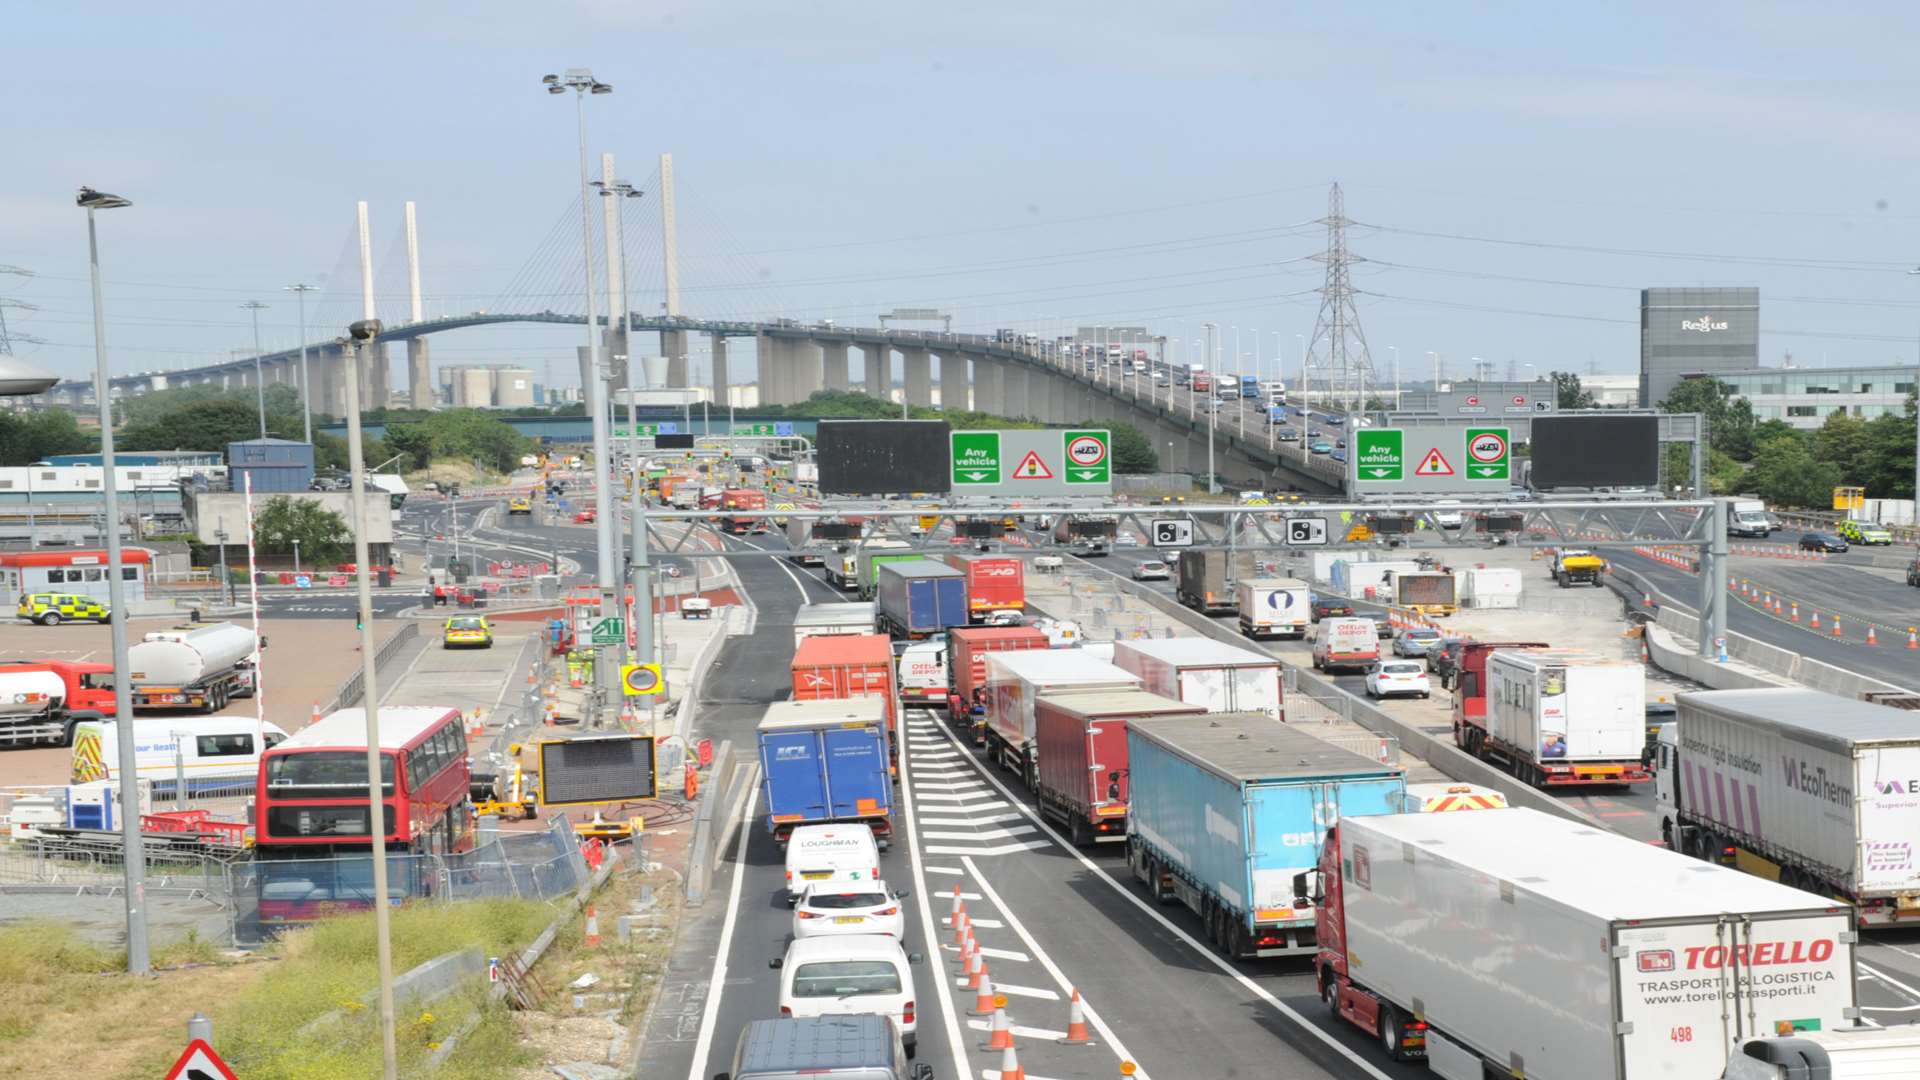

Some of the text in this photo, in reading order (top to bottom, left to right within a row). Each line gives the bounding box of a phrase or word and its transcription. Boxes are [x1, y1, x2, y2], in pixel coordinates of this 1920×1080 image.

[1681, 319, 1728, 332] Regus
[965, 448, 987, 458] Any
[1369, 445, 1391, 454] Any
[956, 457, 997, 466] vehicle
[1360, 454, 1400, 463] vehicle
[1799, 761, 1854, 809] EcoTherm
[1684, 938, 1834, 970] TORELLO
[1738, 975, 1751, 987] &
[1752, 970, 1835, 987] LOGISTICA
[1670, 1026, 1693, 1043] 498
